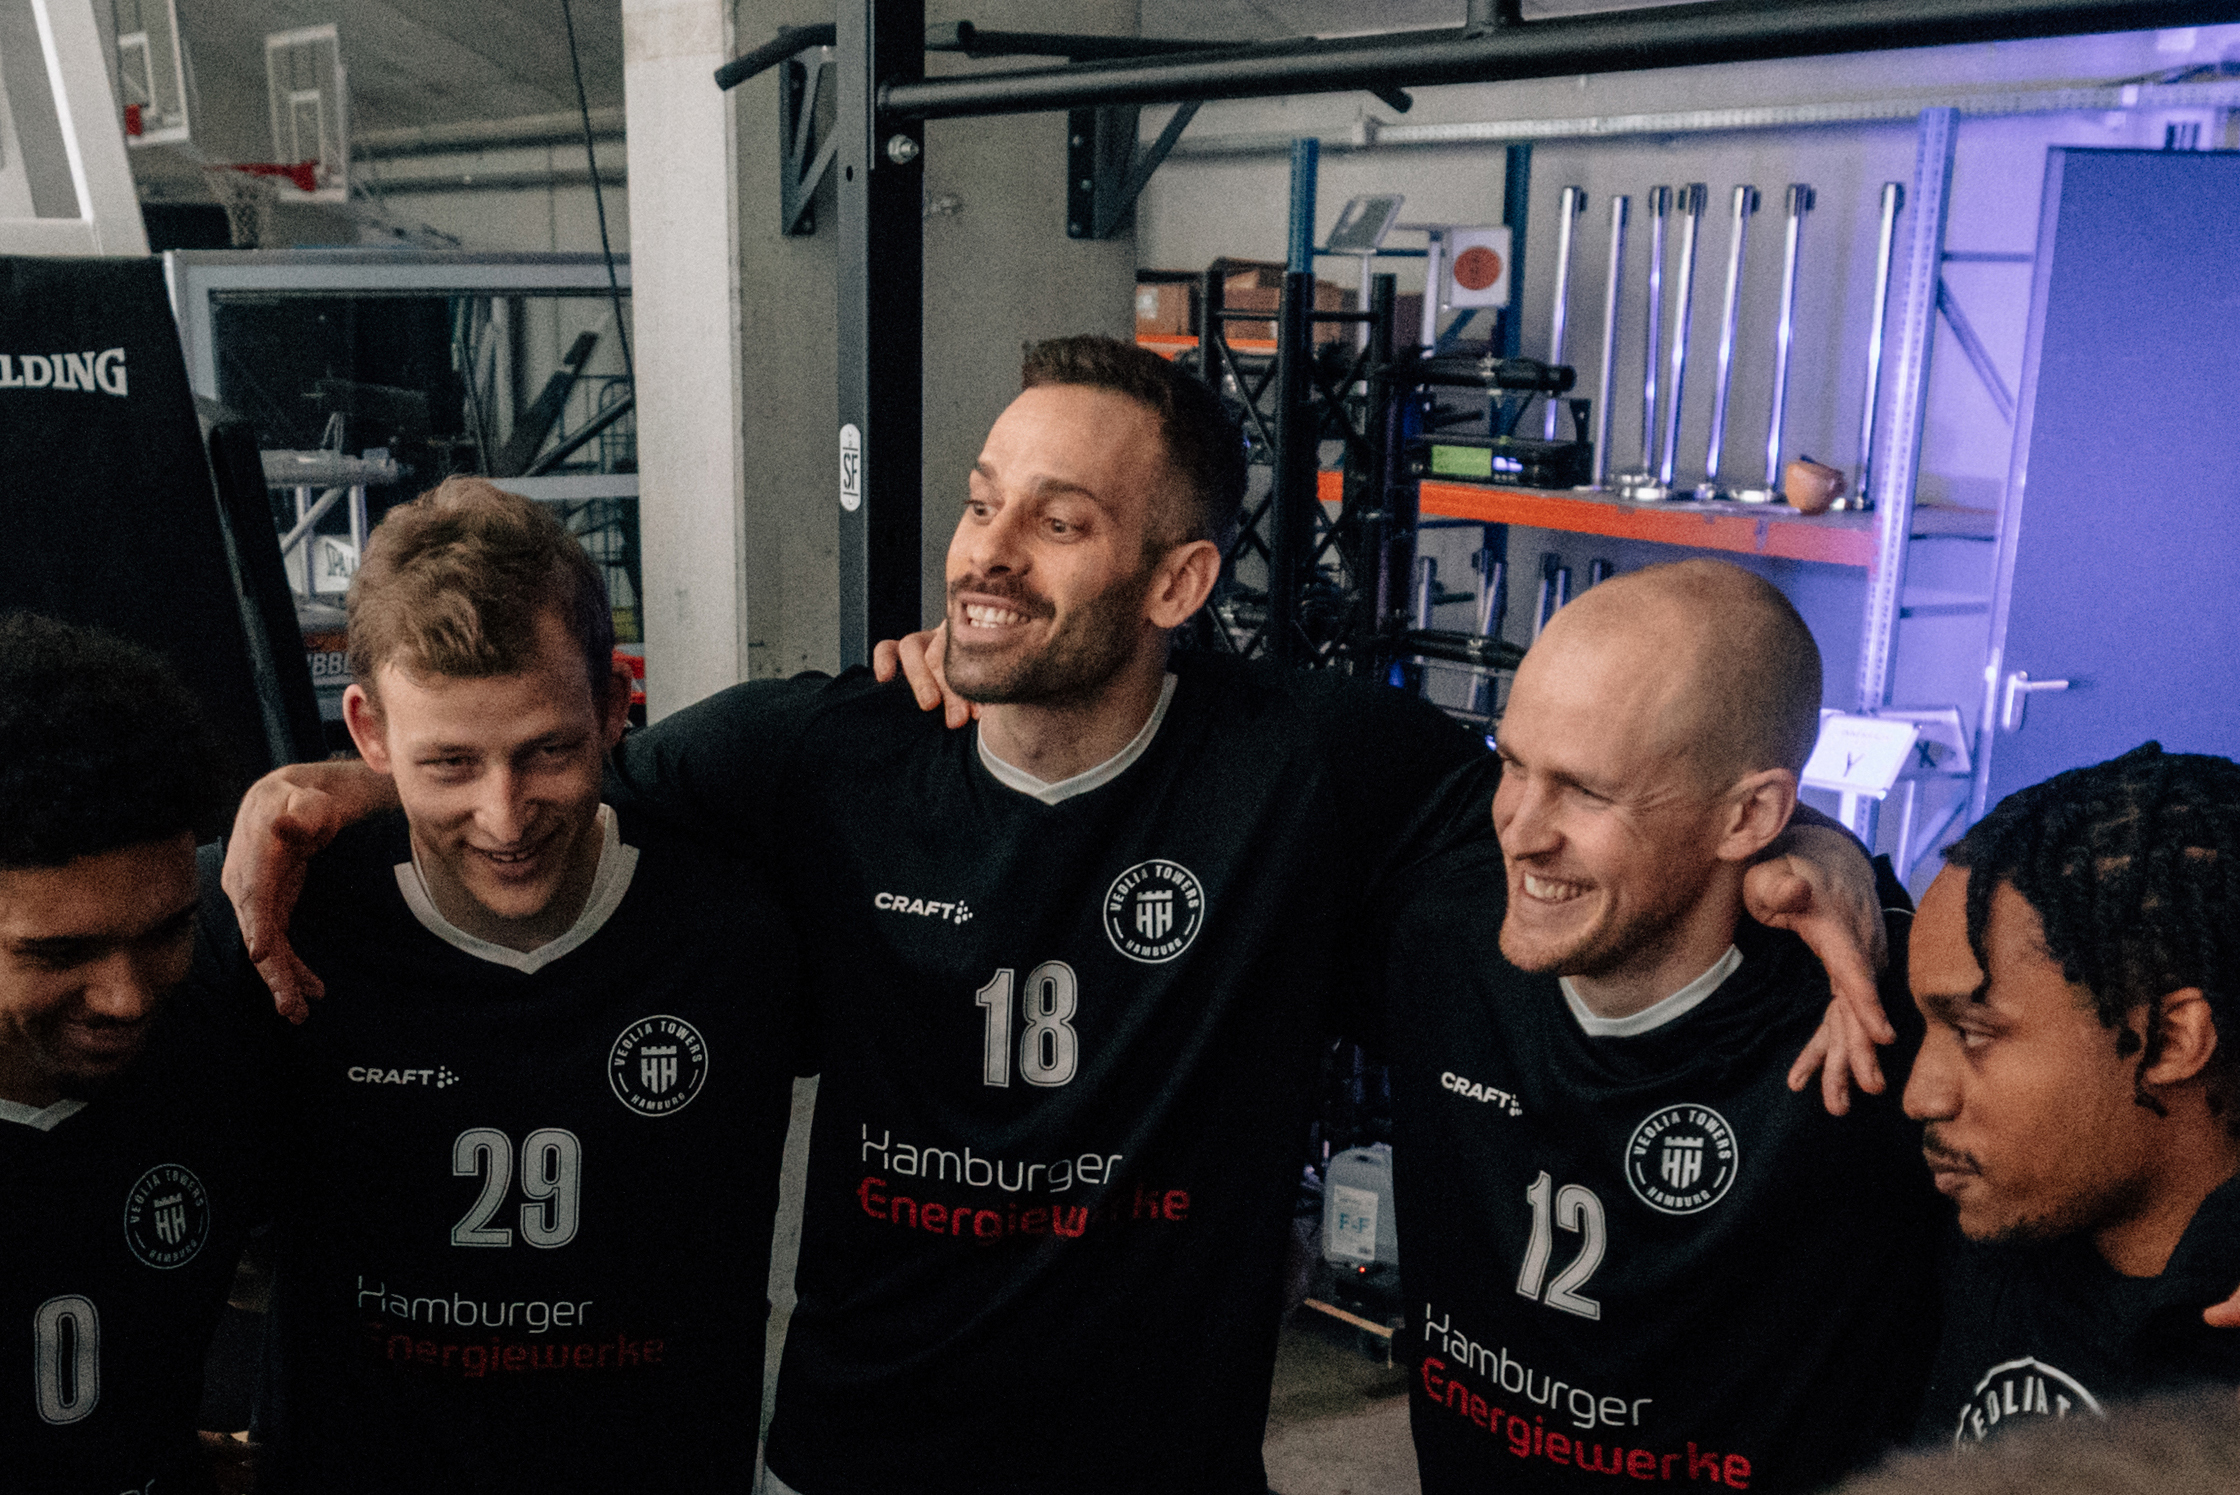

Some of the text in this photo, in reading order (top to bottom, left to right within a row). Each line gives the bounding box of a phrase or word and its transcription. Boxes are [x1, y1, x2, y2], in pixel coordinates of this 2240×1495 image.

[843, 452, 858, 490] SF
[874, 892, 955, 920] CRAFT
[1110, 865, 1199, 911] VEOLIA TOWERS
[1125, 937, 1183, 957] HAMBURG
[614, 1020, 703, 1066] VEOLIA TOWERS
[975, 959, 1078, 1088] 18
[347, 1066, 434, 1086] CRAFT
[631, 1092, 685, 1110] HAMBURG
[1440, 1071, 1511, 1109] CRAFT
[862, 1123, 1123, 1193] Hamburger
[1633, 1110, 1731, 1159] VEOLIA TOWERS
[130, 1169, 204, 1223] VEOLIA TOWERS
[451, 1127, 582, 1249] 29
[856, 1176, 1190, 1246] Energiewke
[1646, 1186, 1711, 1208] HAMBURG
[149, 1239, 198, 1263] HAMBURG
[1516, 1169, 1607, 1321] 12
[357, 1275, 593, 1334] Hamburger
[33, 1294, 101, 1426] 0
[1424, 1302, 1654, 1429] Hamburger
[1420, 1356, 1752, 1491] Energiewerke
[1966, 1376, 2049, 1444] EOLIA
